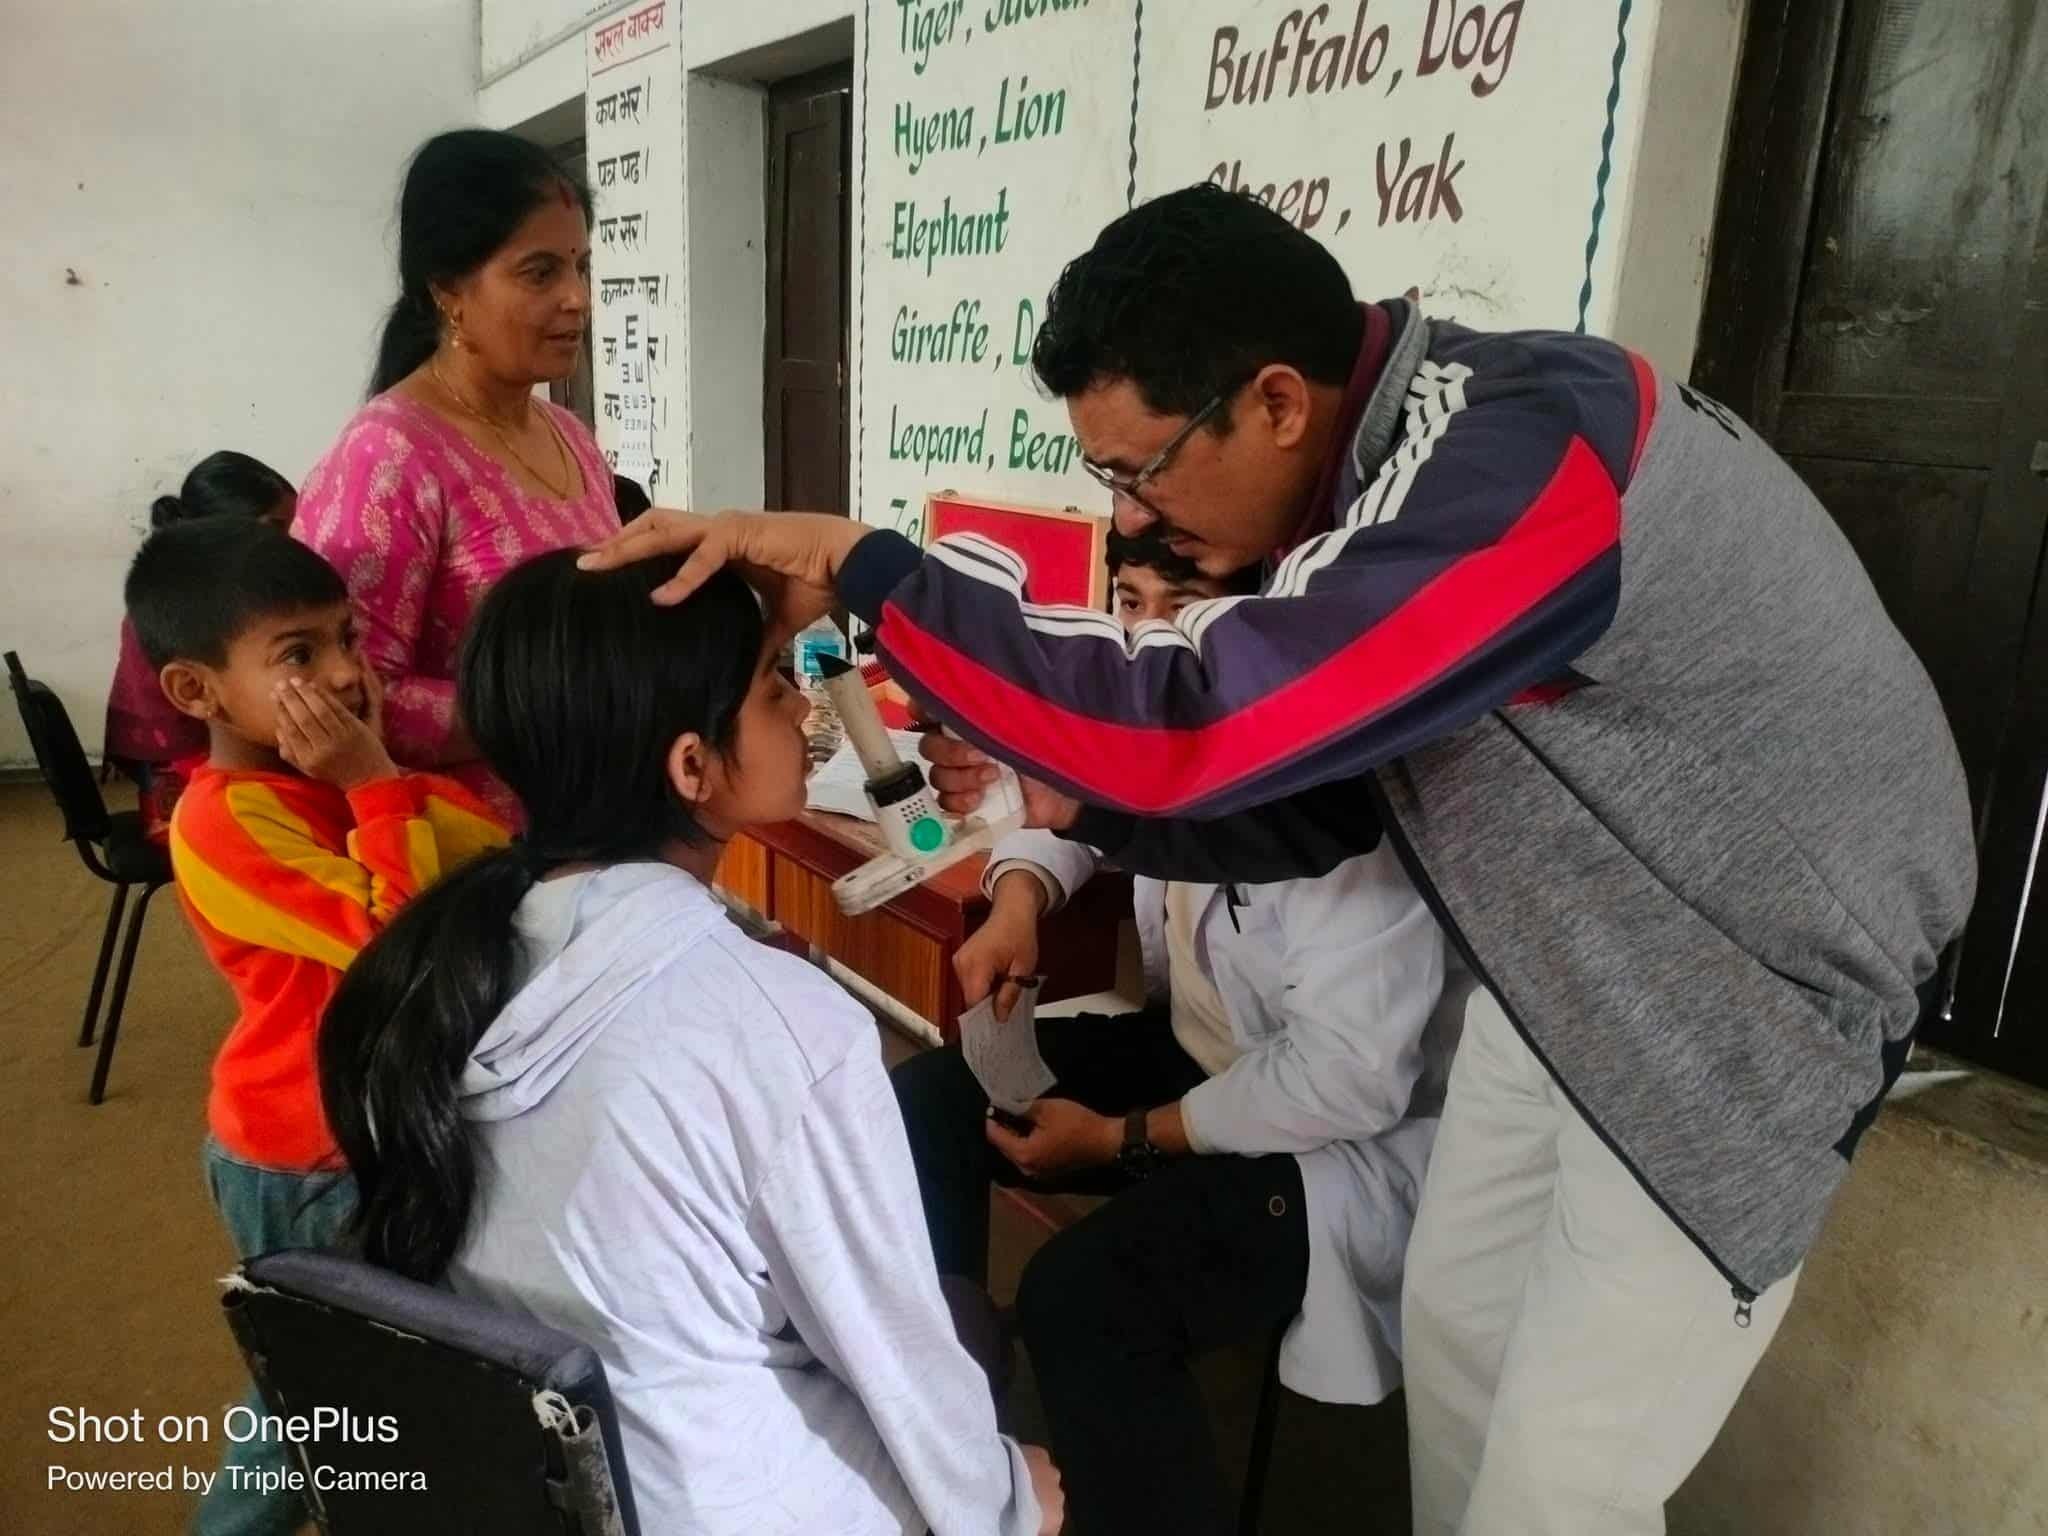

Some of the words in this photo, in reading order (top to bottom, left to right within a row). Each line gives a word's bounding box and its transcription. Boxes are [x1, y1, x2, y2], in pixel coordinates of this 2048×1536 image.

[1203, 0, 1403, 111] Buffalo,
[1416, 0, 1526, 98] Dog
[894, 101, 987, 176] Hyena,
[994, 75, 1066, 145] Lion
[1375, 131, 1466, 227] Yak
[892, 186, 1010, 278] Elephant
[891, 298, 1002, 373] Giraffe,
[889, 403, 994, 477] Leopard,
